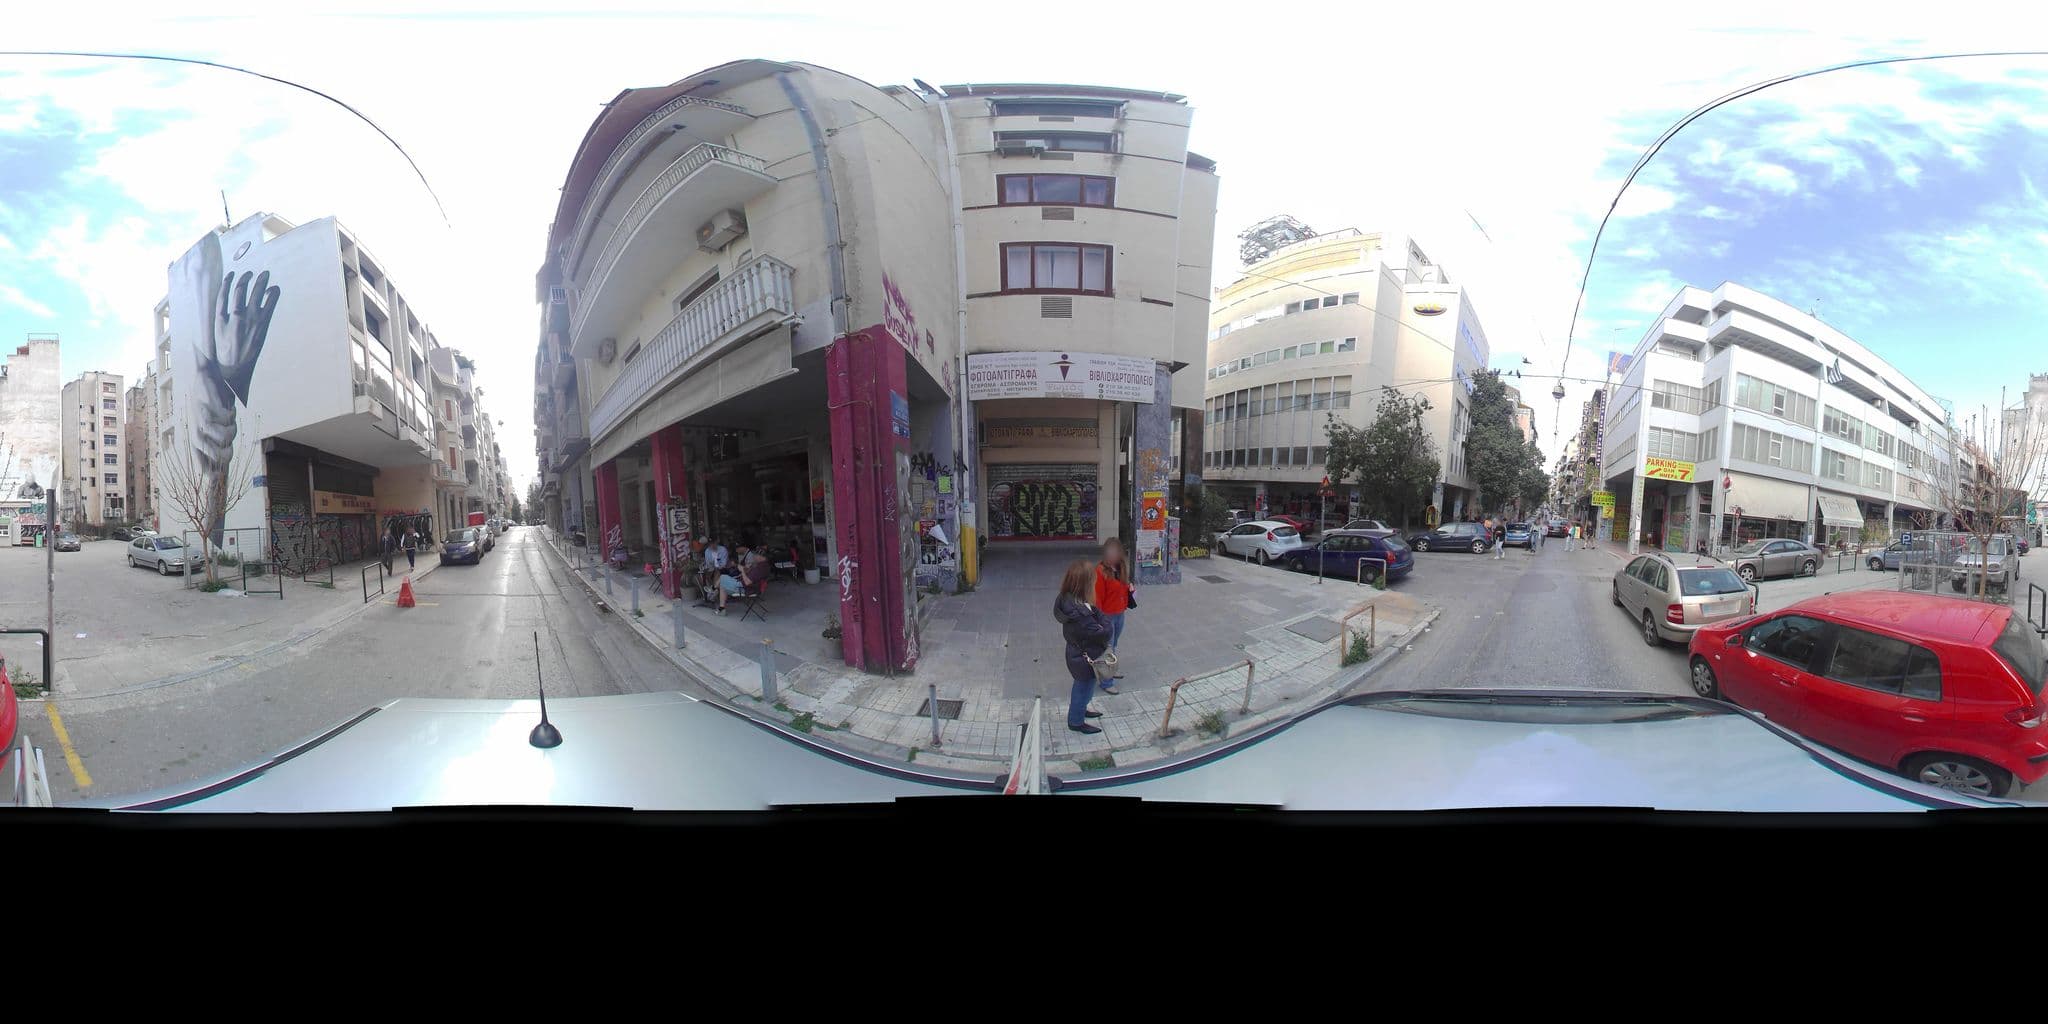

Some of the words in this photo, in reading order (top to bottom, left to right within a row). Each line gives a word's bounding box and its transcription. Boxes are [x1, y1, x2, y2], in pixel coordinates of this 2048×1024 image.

[970, 369, 1037, 382] ΦΩΤΟΑΝΤΙΓΡΑΦΑ
[1089, 370, 1153, 386] ΒΙΒΛΙΟΧΑΡΤΟΠΩΛΕΙΟ
[1646, 457, 1677, 469] PARKING
[1678, 469, 1690, 480] 7
